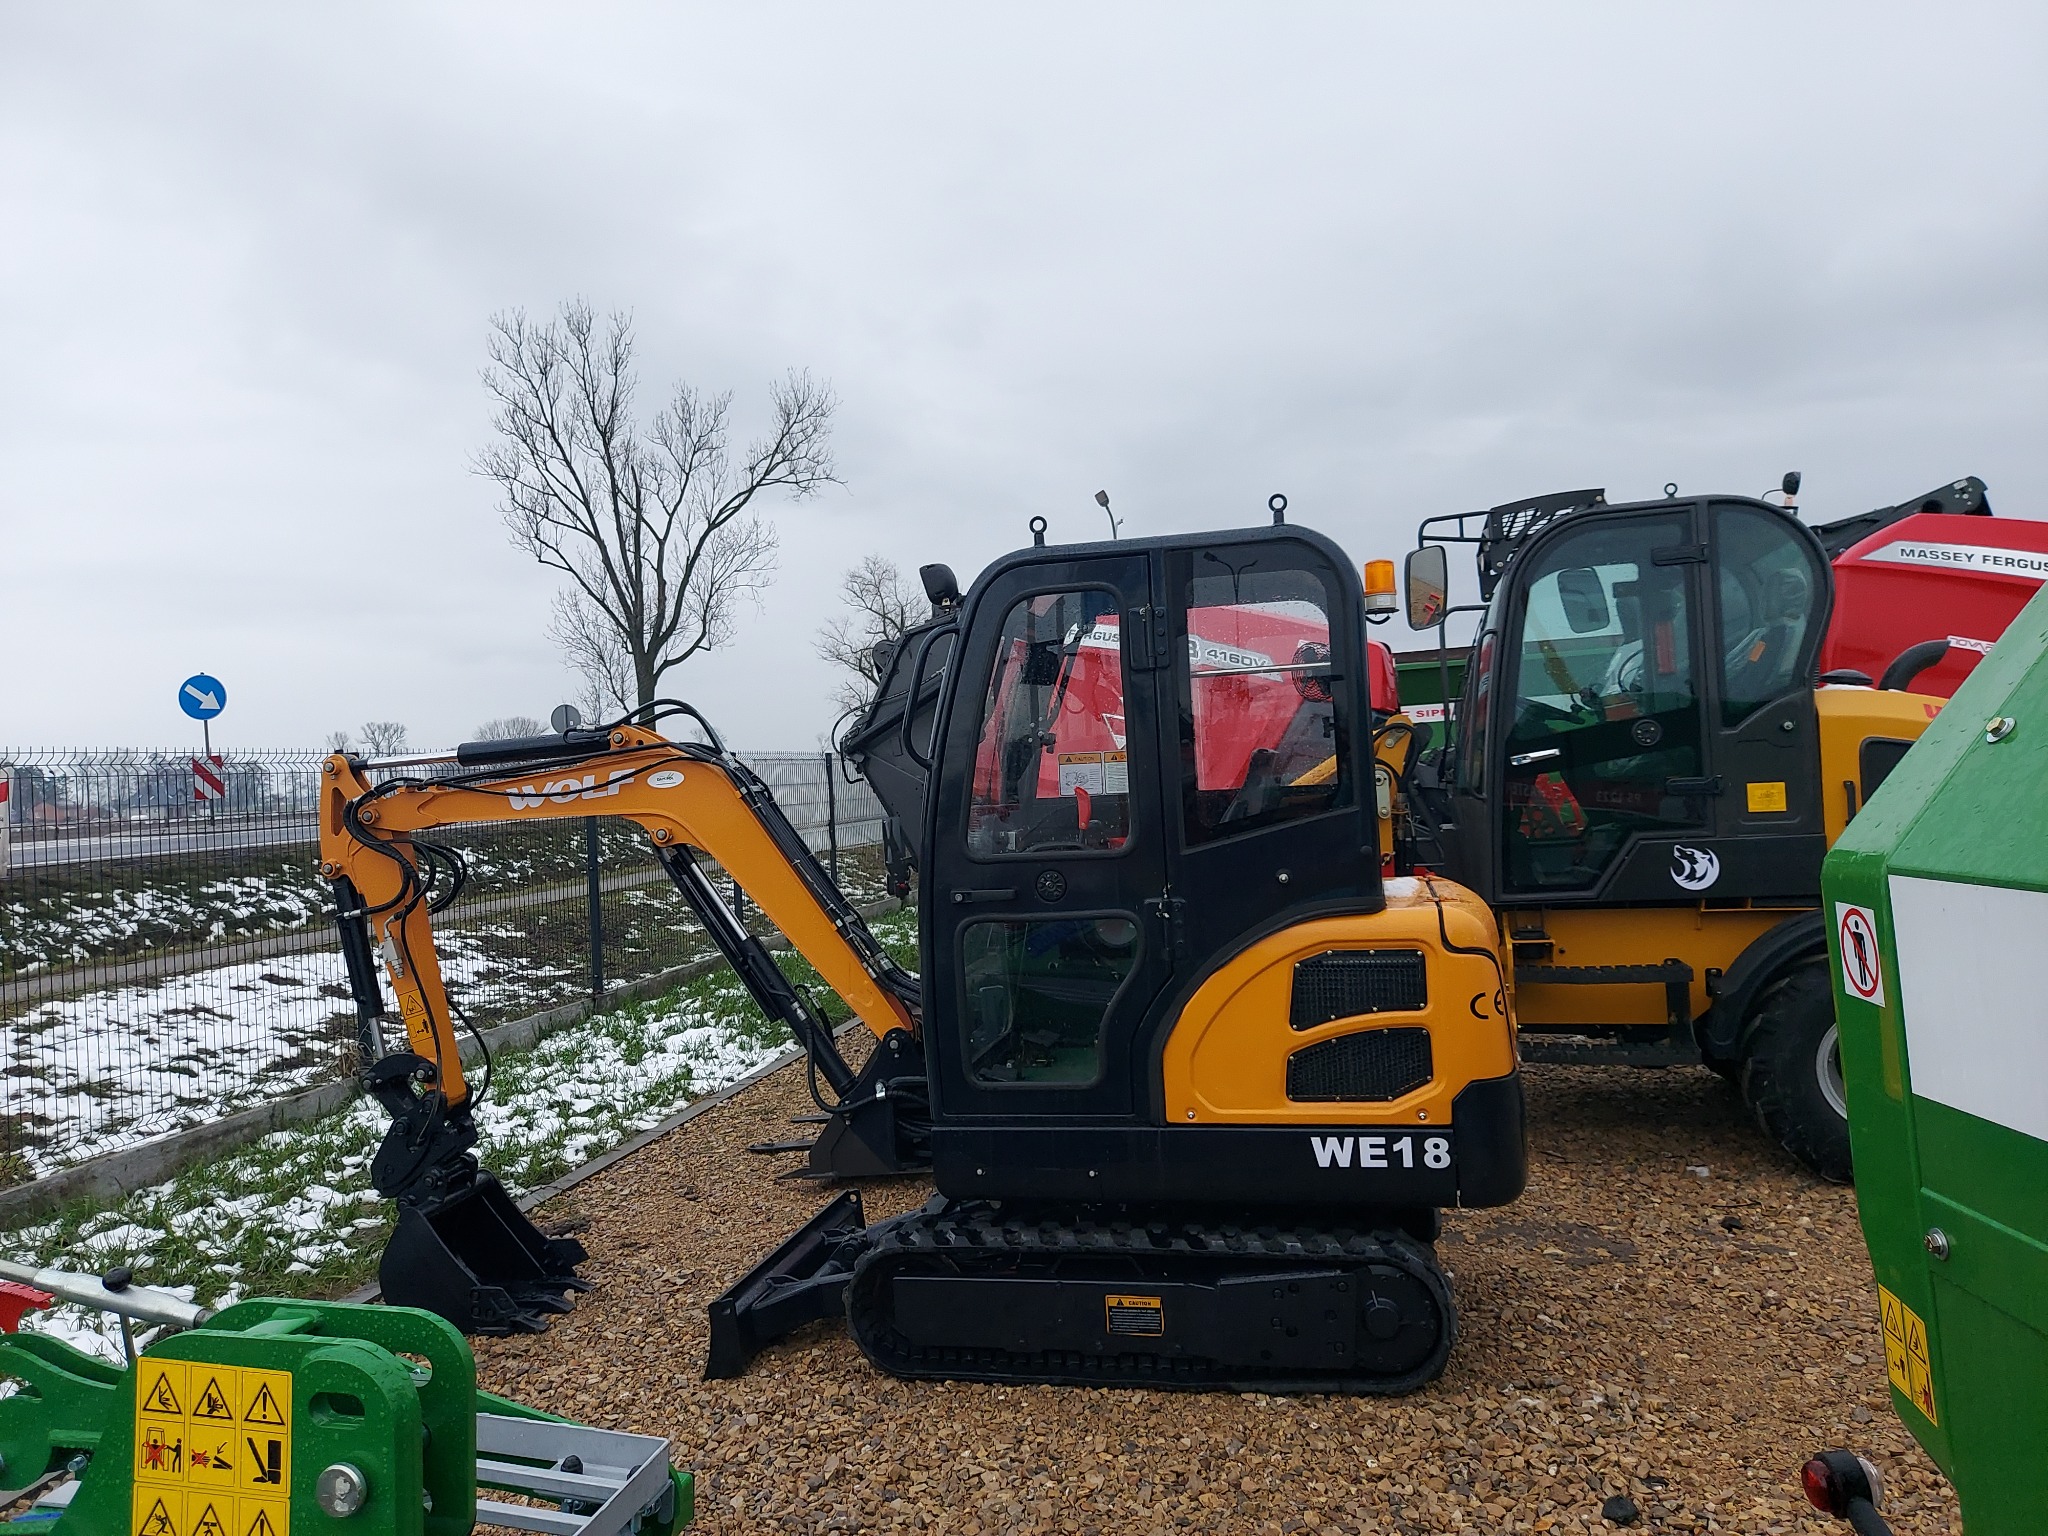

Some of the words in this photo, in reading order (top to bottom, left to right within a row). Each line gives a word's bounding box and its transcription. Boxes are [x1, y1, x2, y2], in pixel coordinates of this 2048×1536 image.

[1900, 548, 1975, 563] MASSEY
[506, 768, 636, 811] WOLF
[1310, 1136, 1451, 1169] WE18
